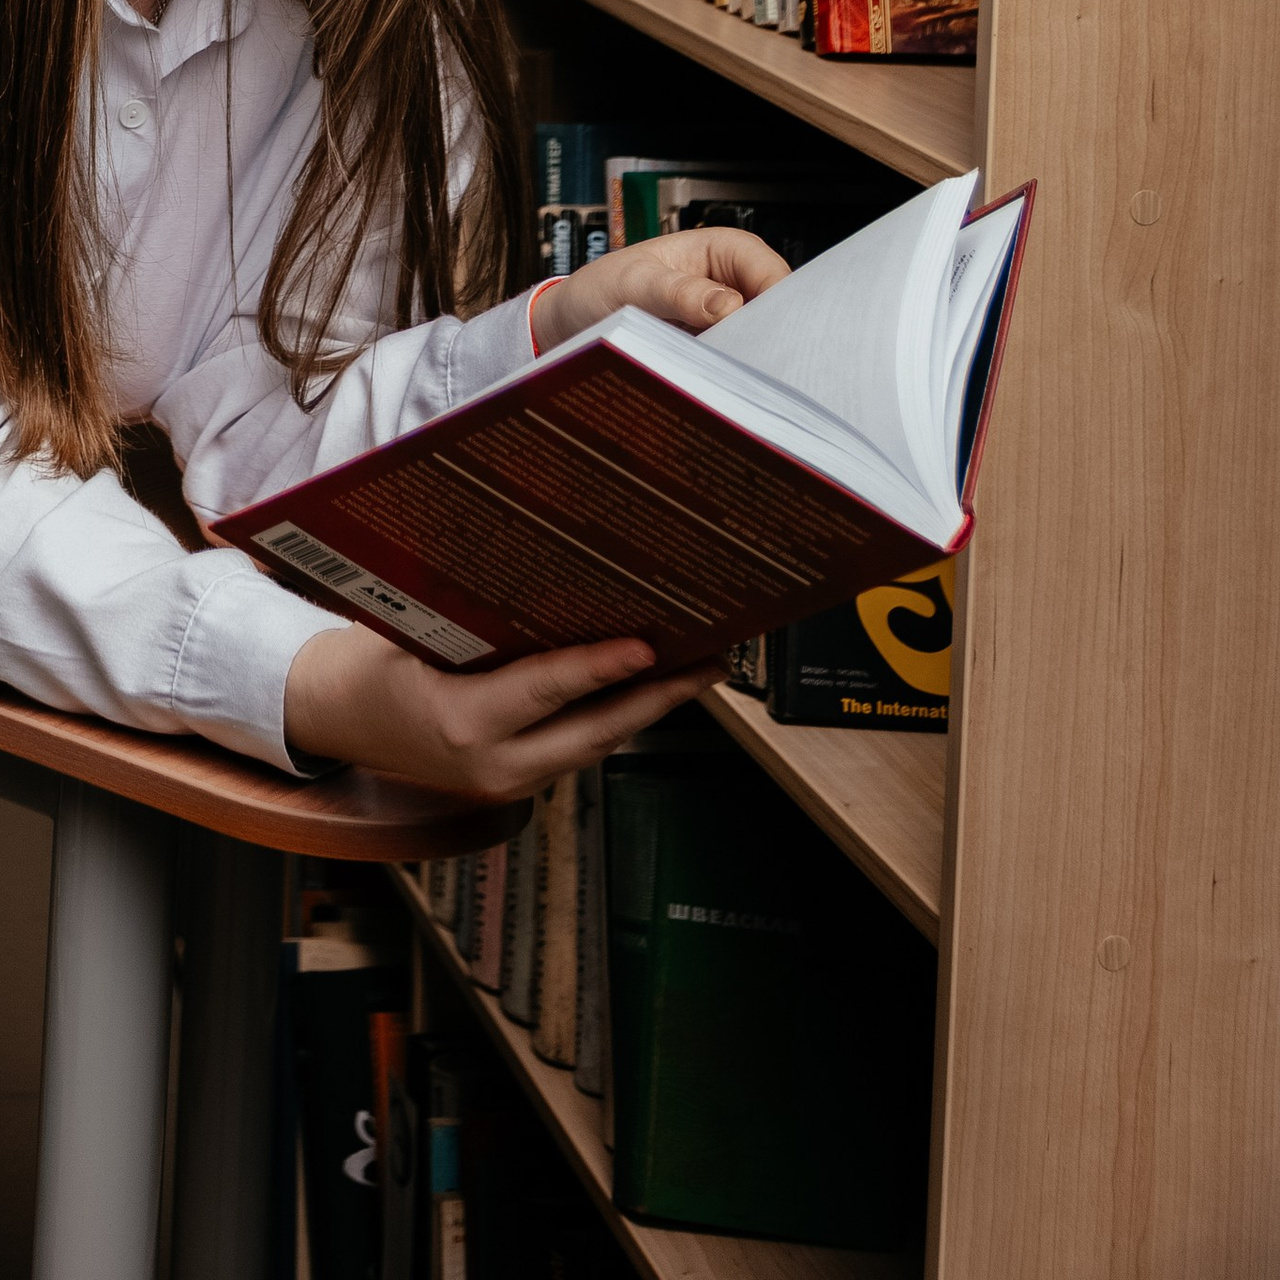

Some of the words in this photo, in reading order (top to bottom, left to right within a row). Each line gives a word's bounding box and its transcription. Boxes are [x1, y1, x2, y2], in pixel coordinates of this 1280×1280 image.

[777, 551, 800, 564] BOOK
[796, 562, 826, 580] REVIEW
[371, 579, 399, 595] Думай
[396, 595, 437, 619] по-своему
[664, 581, 710, 609] WASHINGTON
[706, 607, 728, 620] POST
[520, 627, 543, 641] WALL
[840, 697, 872, 715] The
[877, 700, 948, 719] Internat
